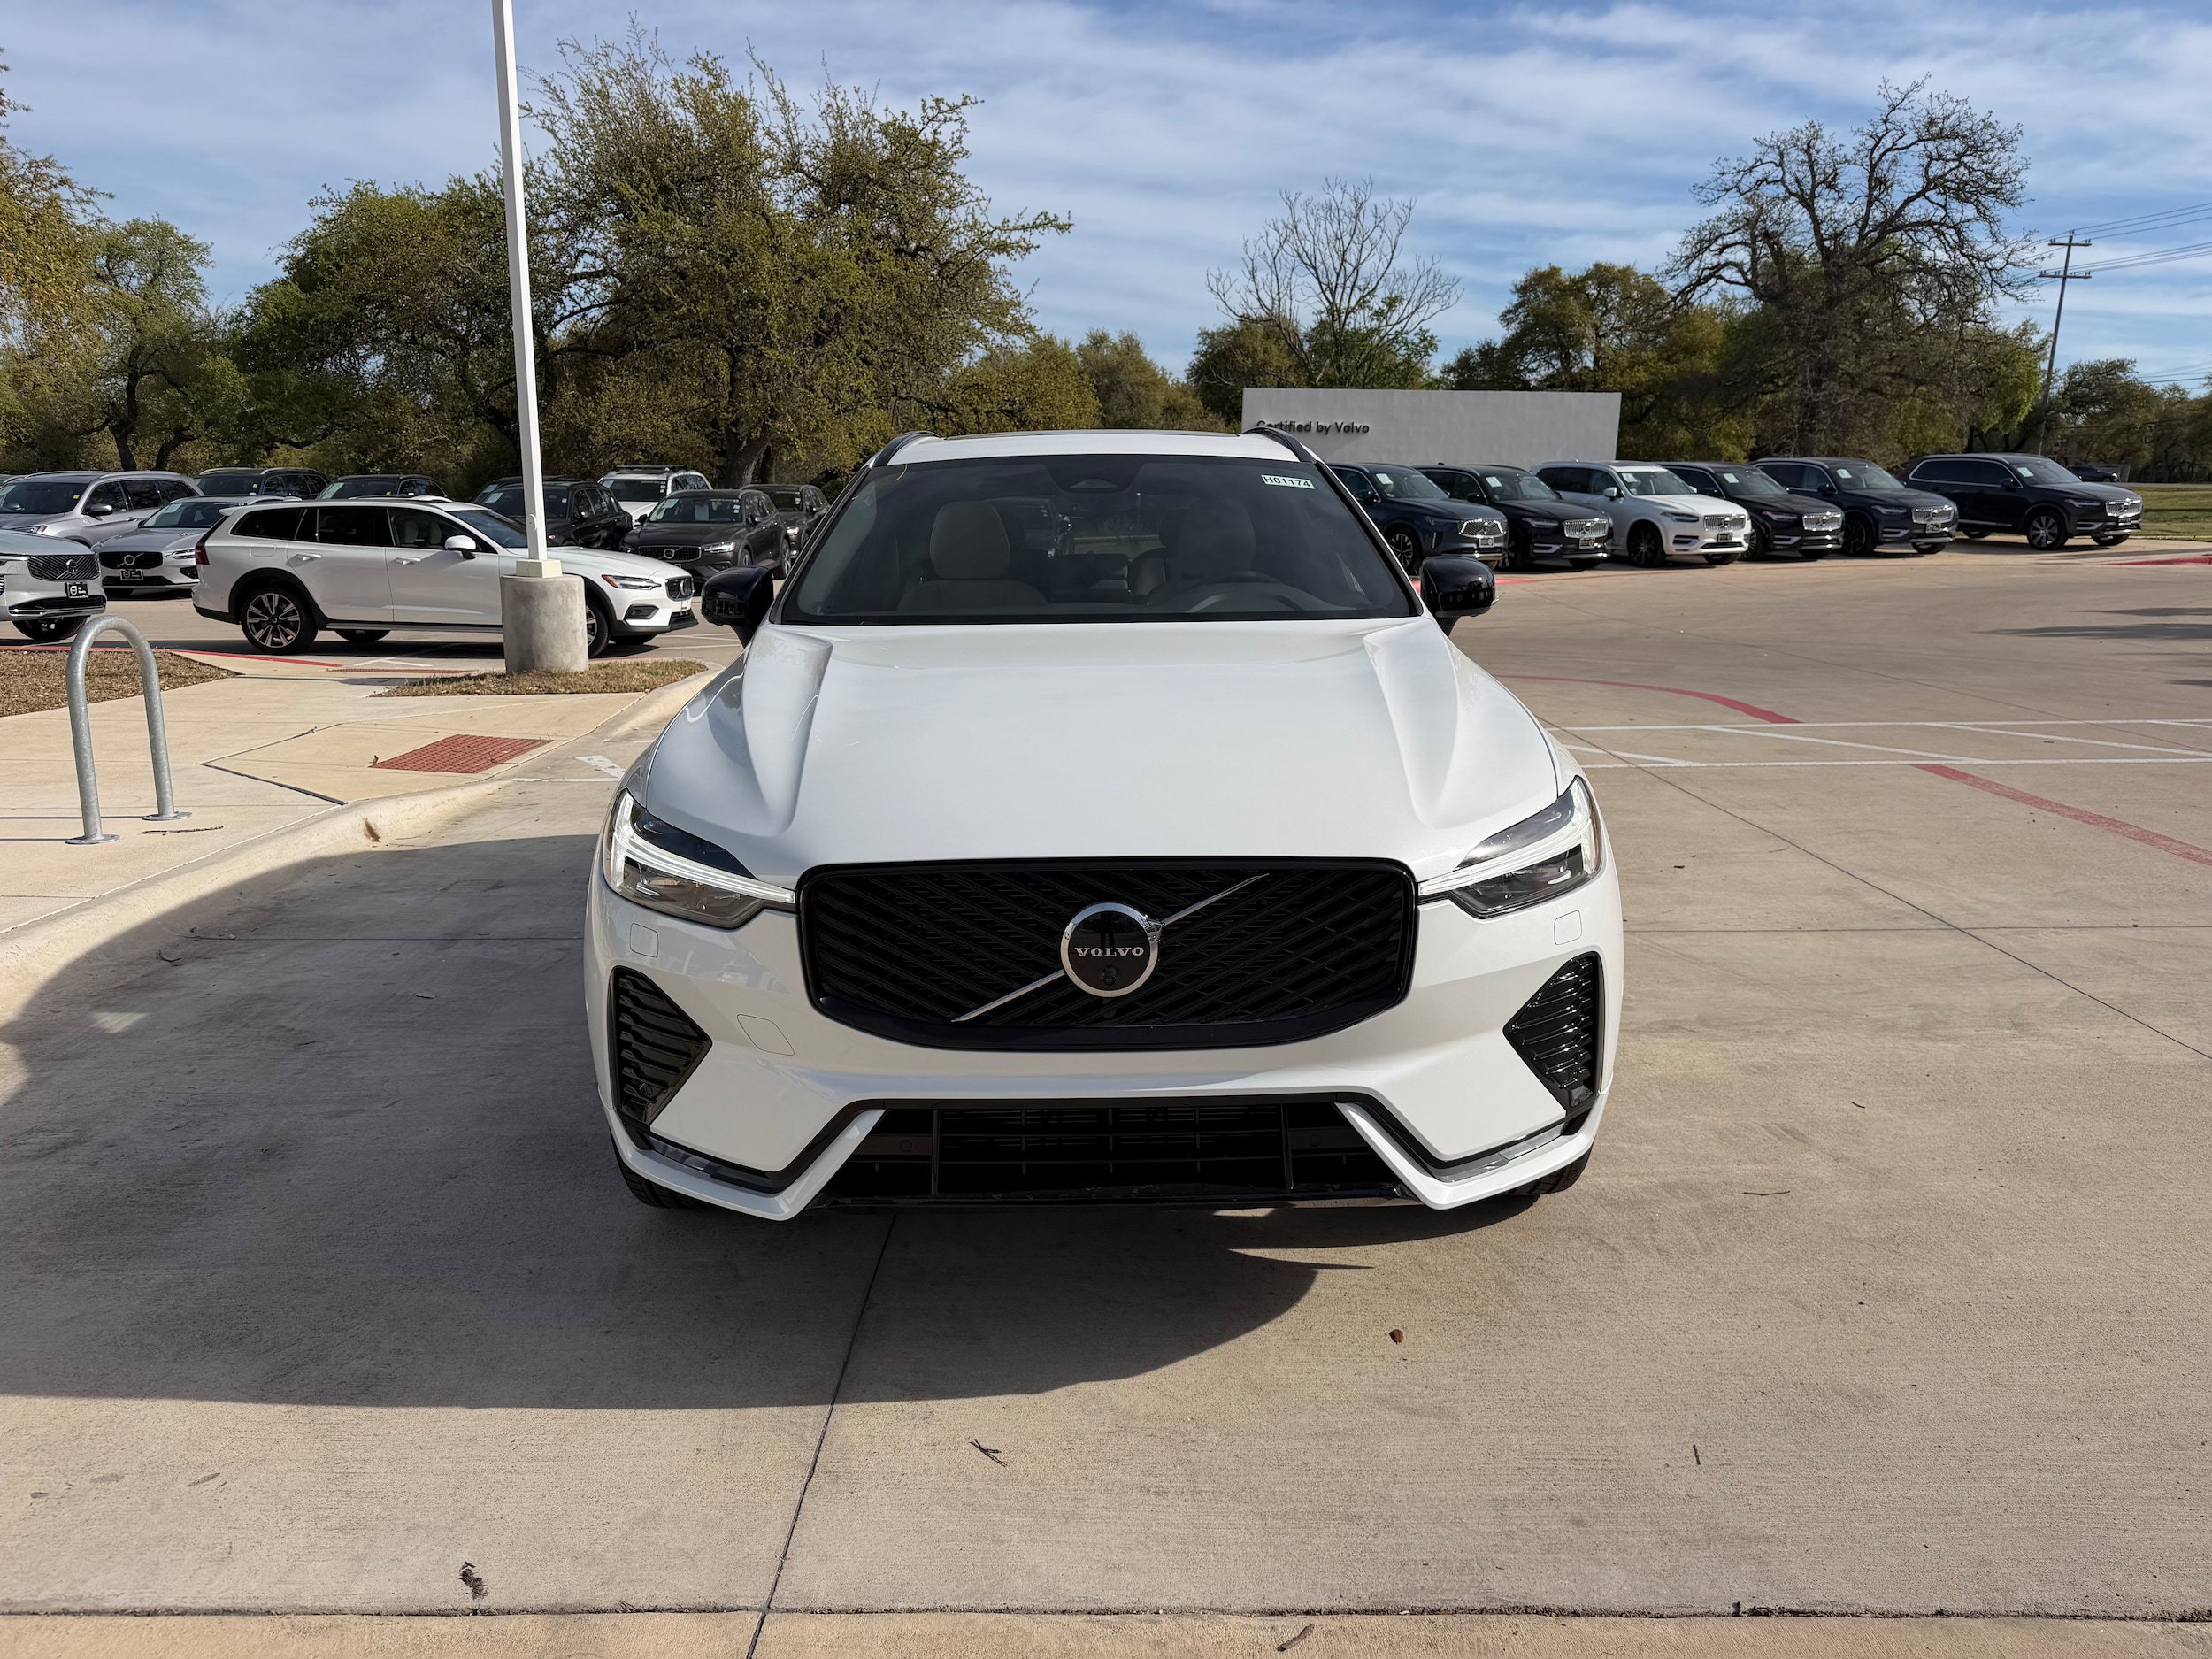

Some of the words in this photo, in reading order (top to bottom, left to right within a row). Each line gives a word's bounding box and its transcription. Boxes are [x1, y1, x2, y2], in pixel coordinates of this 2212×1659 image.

[1317, 421, 1331, 435] by
[1335, 421, 1370, 433] Volvo
[1263, 476, 1310, 487] H01174
[1074, 947, 1144, 956] VOLVO
